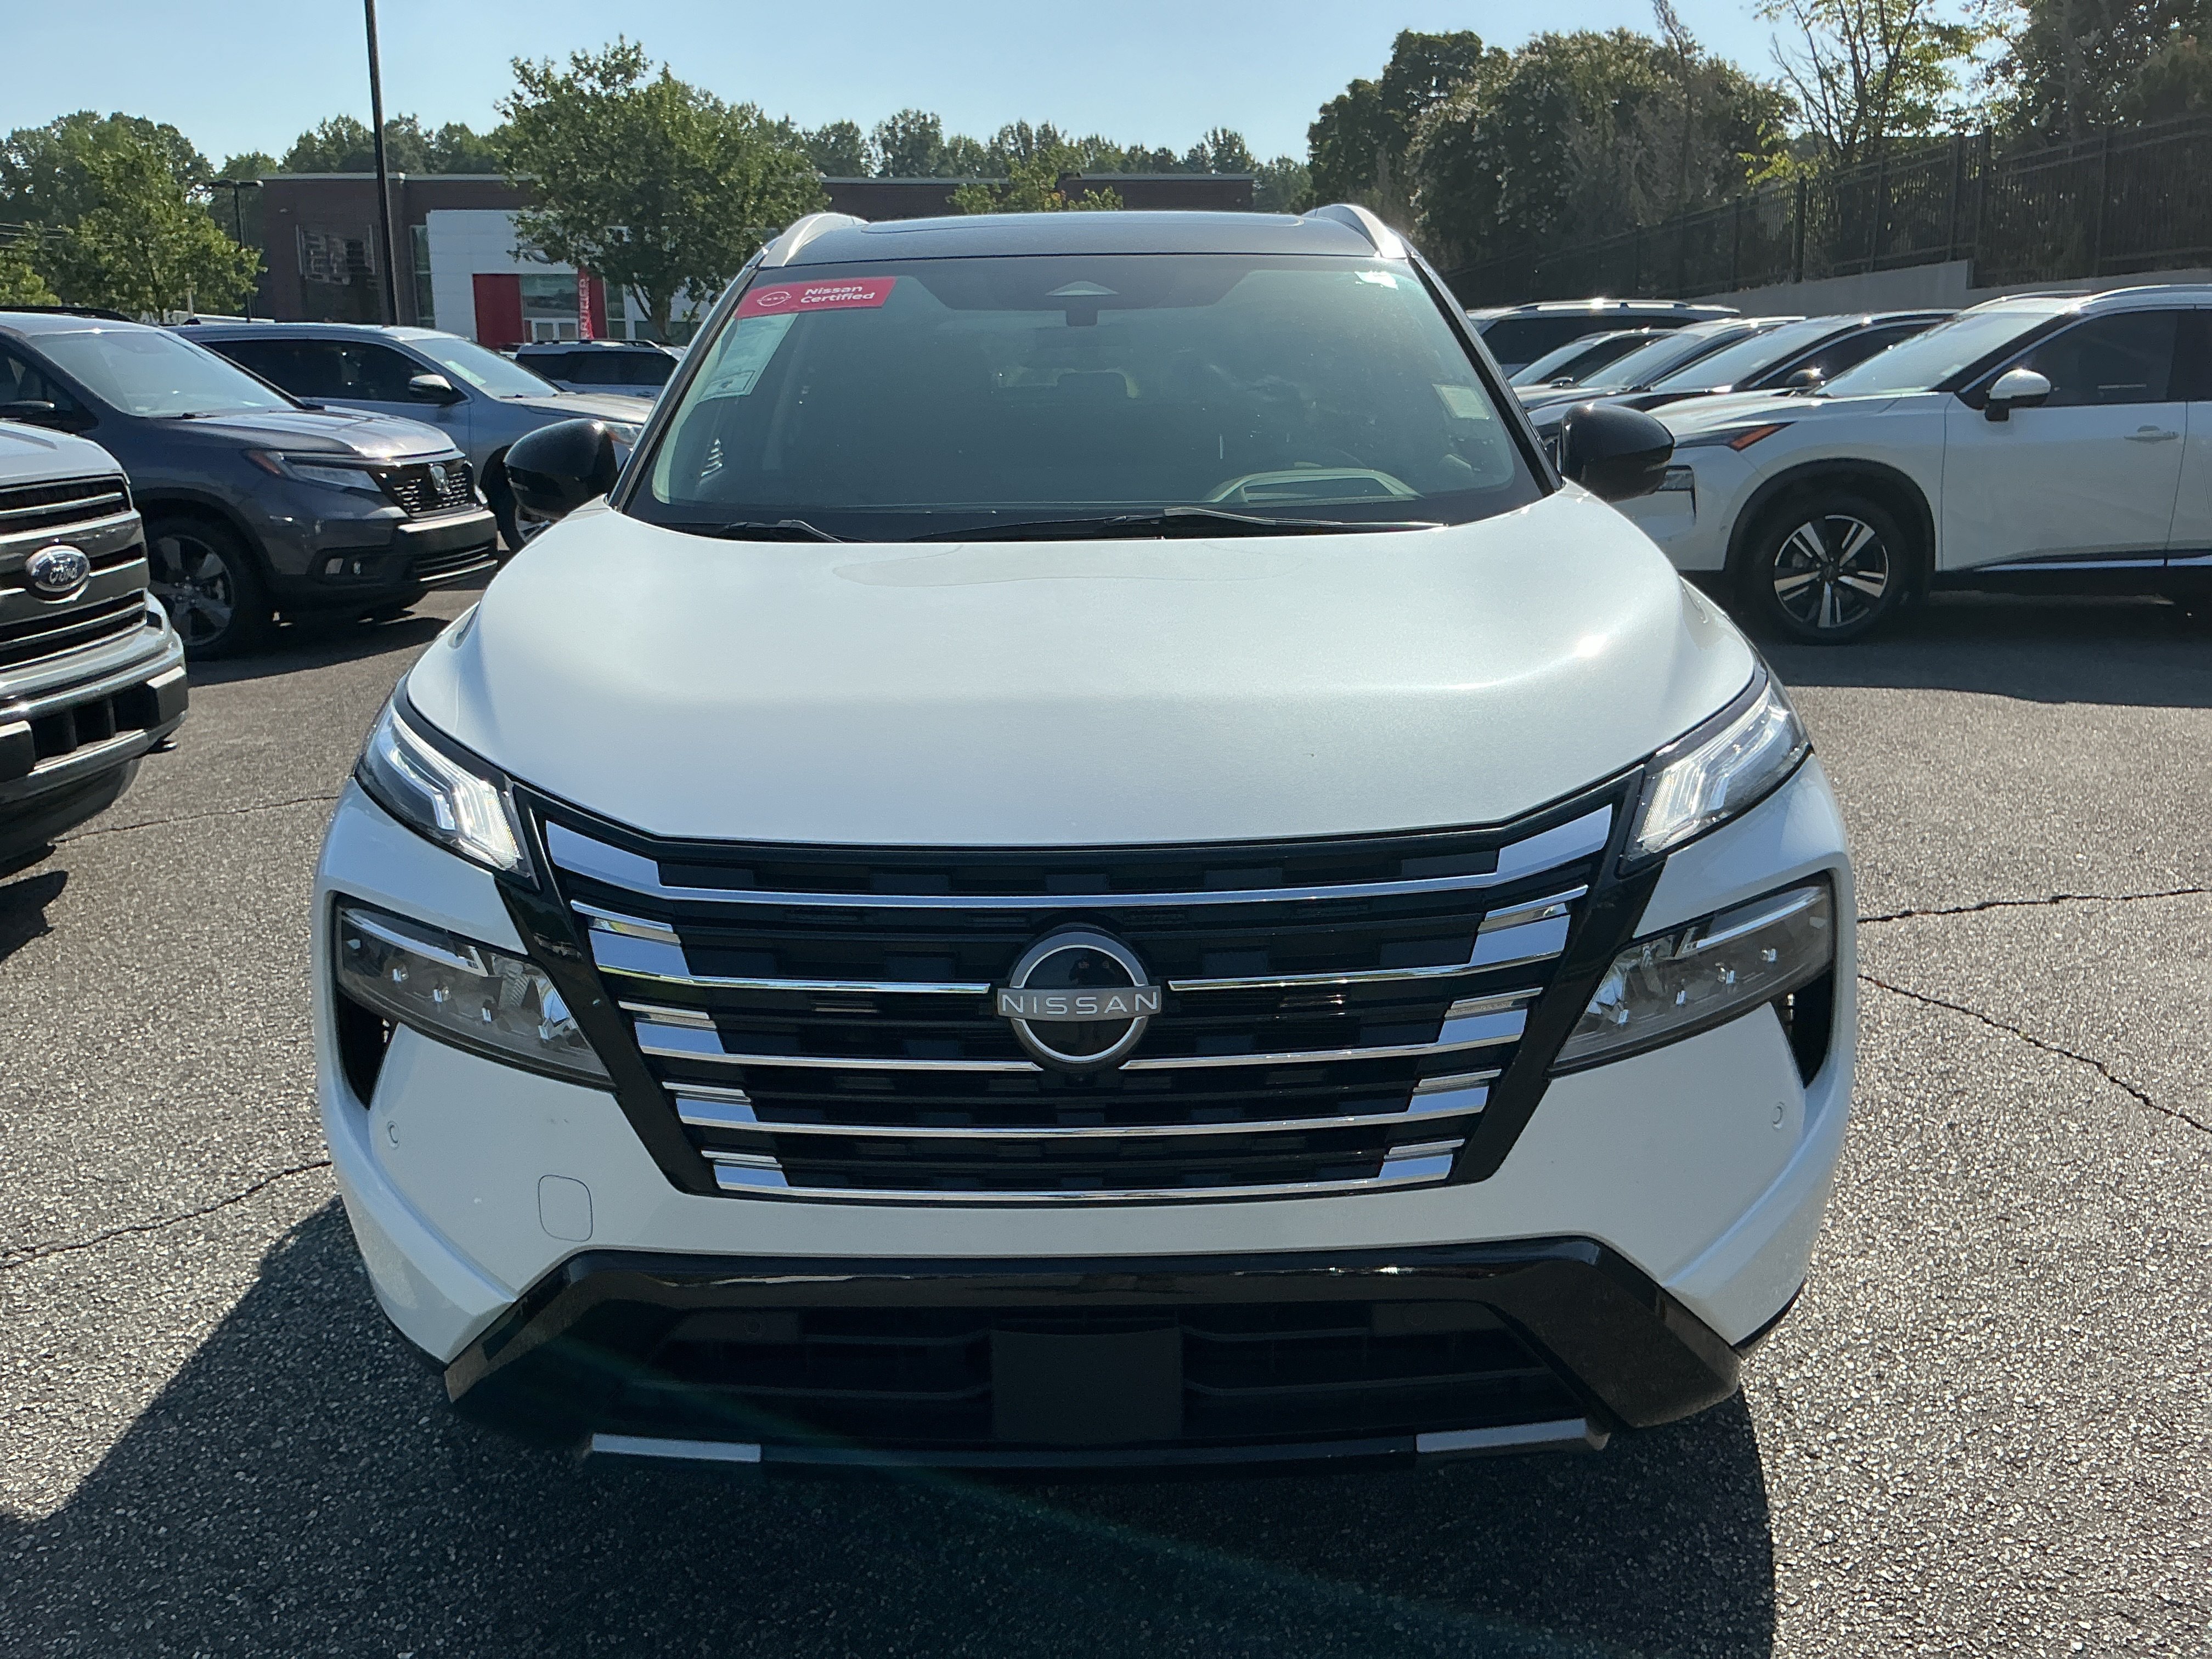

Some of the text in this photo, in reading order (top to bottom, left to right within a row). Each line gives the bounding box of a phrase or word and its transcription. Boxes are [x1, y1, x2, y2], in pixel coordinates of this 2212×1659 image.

[805, 286, 863, 295] Nissan
[800, 292, 876, 303] Certified
[1002, 991, 1157, 1014] NISSAN
